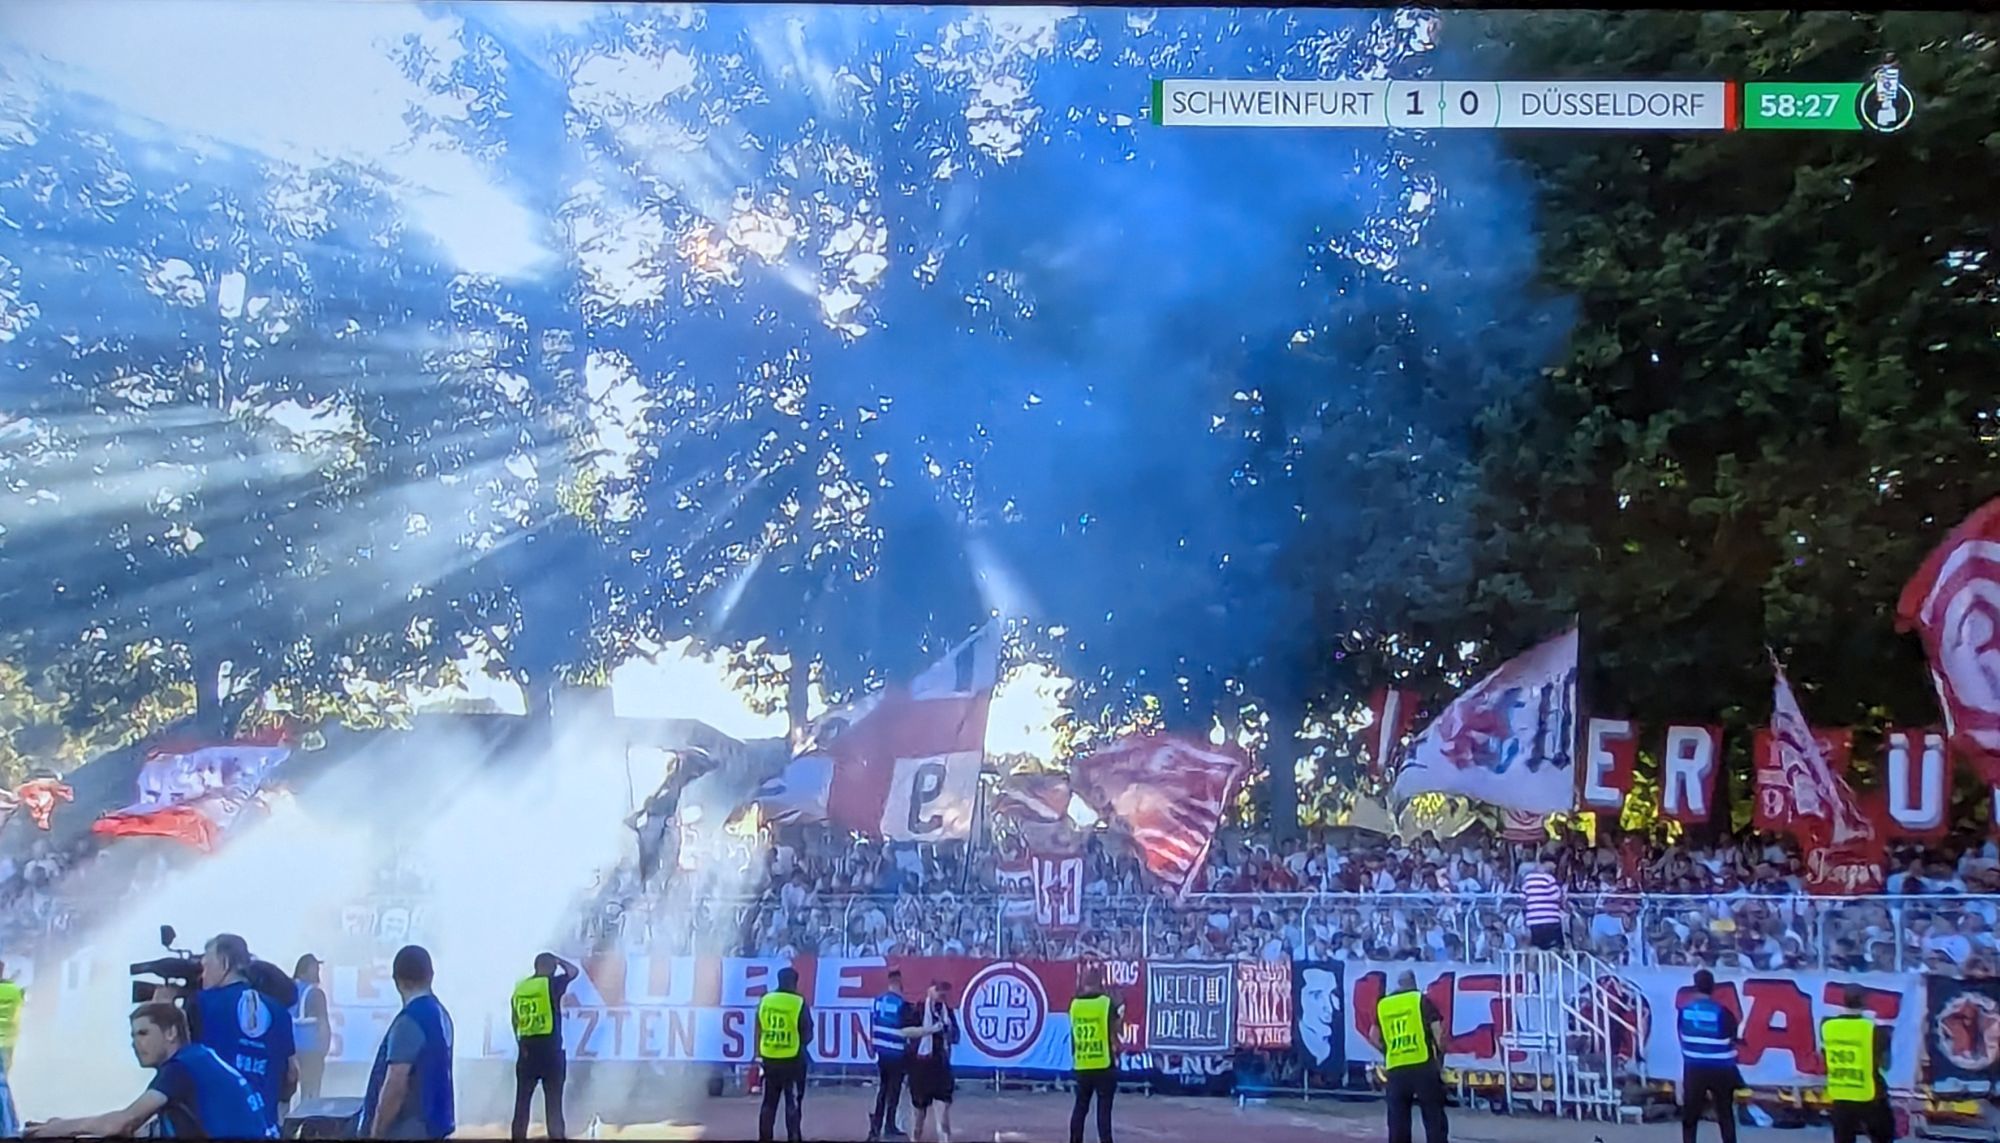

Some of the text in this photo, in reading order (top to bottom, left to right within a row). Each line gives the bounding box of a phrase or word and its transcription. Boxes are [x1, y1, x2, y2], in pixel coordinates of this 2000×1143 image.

[1172, 87, 1704, 116] SCHWEINFURT 1 0 DÜSSELDORF
[1760, 94, 1840, 117] 58:27
